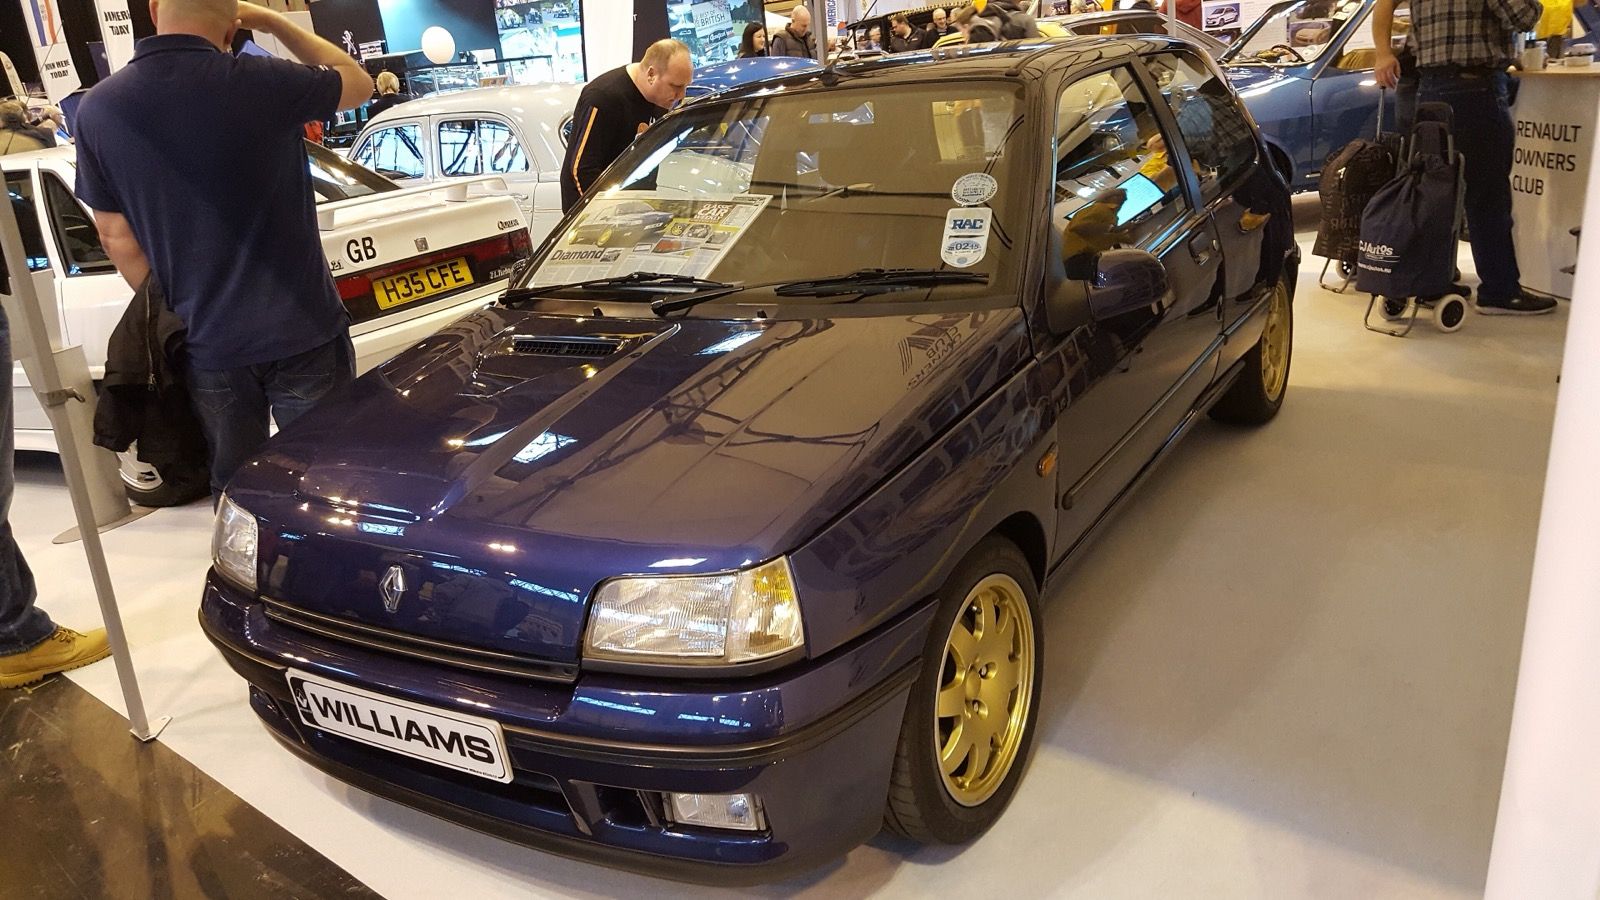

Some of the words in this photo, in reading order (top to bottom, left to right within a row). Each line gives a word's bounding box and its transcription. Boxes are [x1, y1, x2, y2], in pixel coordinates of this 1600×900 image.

[700, 12, 726, 27] BRITISH
[50, 69, 69, 79] TODAY
[1516, 120, 1582, 143] RENAULT
[1514, 147, 1577, 172] OWNERS
[1512, 174, 1544, 196] CLUB
[697, 207, 729, 217] CAR
[952, 219, 984, 230] RAC
[346, 236, 377, 263] GB
[550, 247, 607, 261] Diamond
[382, 272, 426, 303] H35
[425, 261, 465, 289] CFE
[310, 692, 495, 765] WILLIAMS
